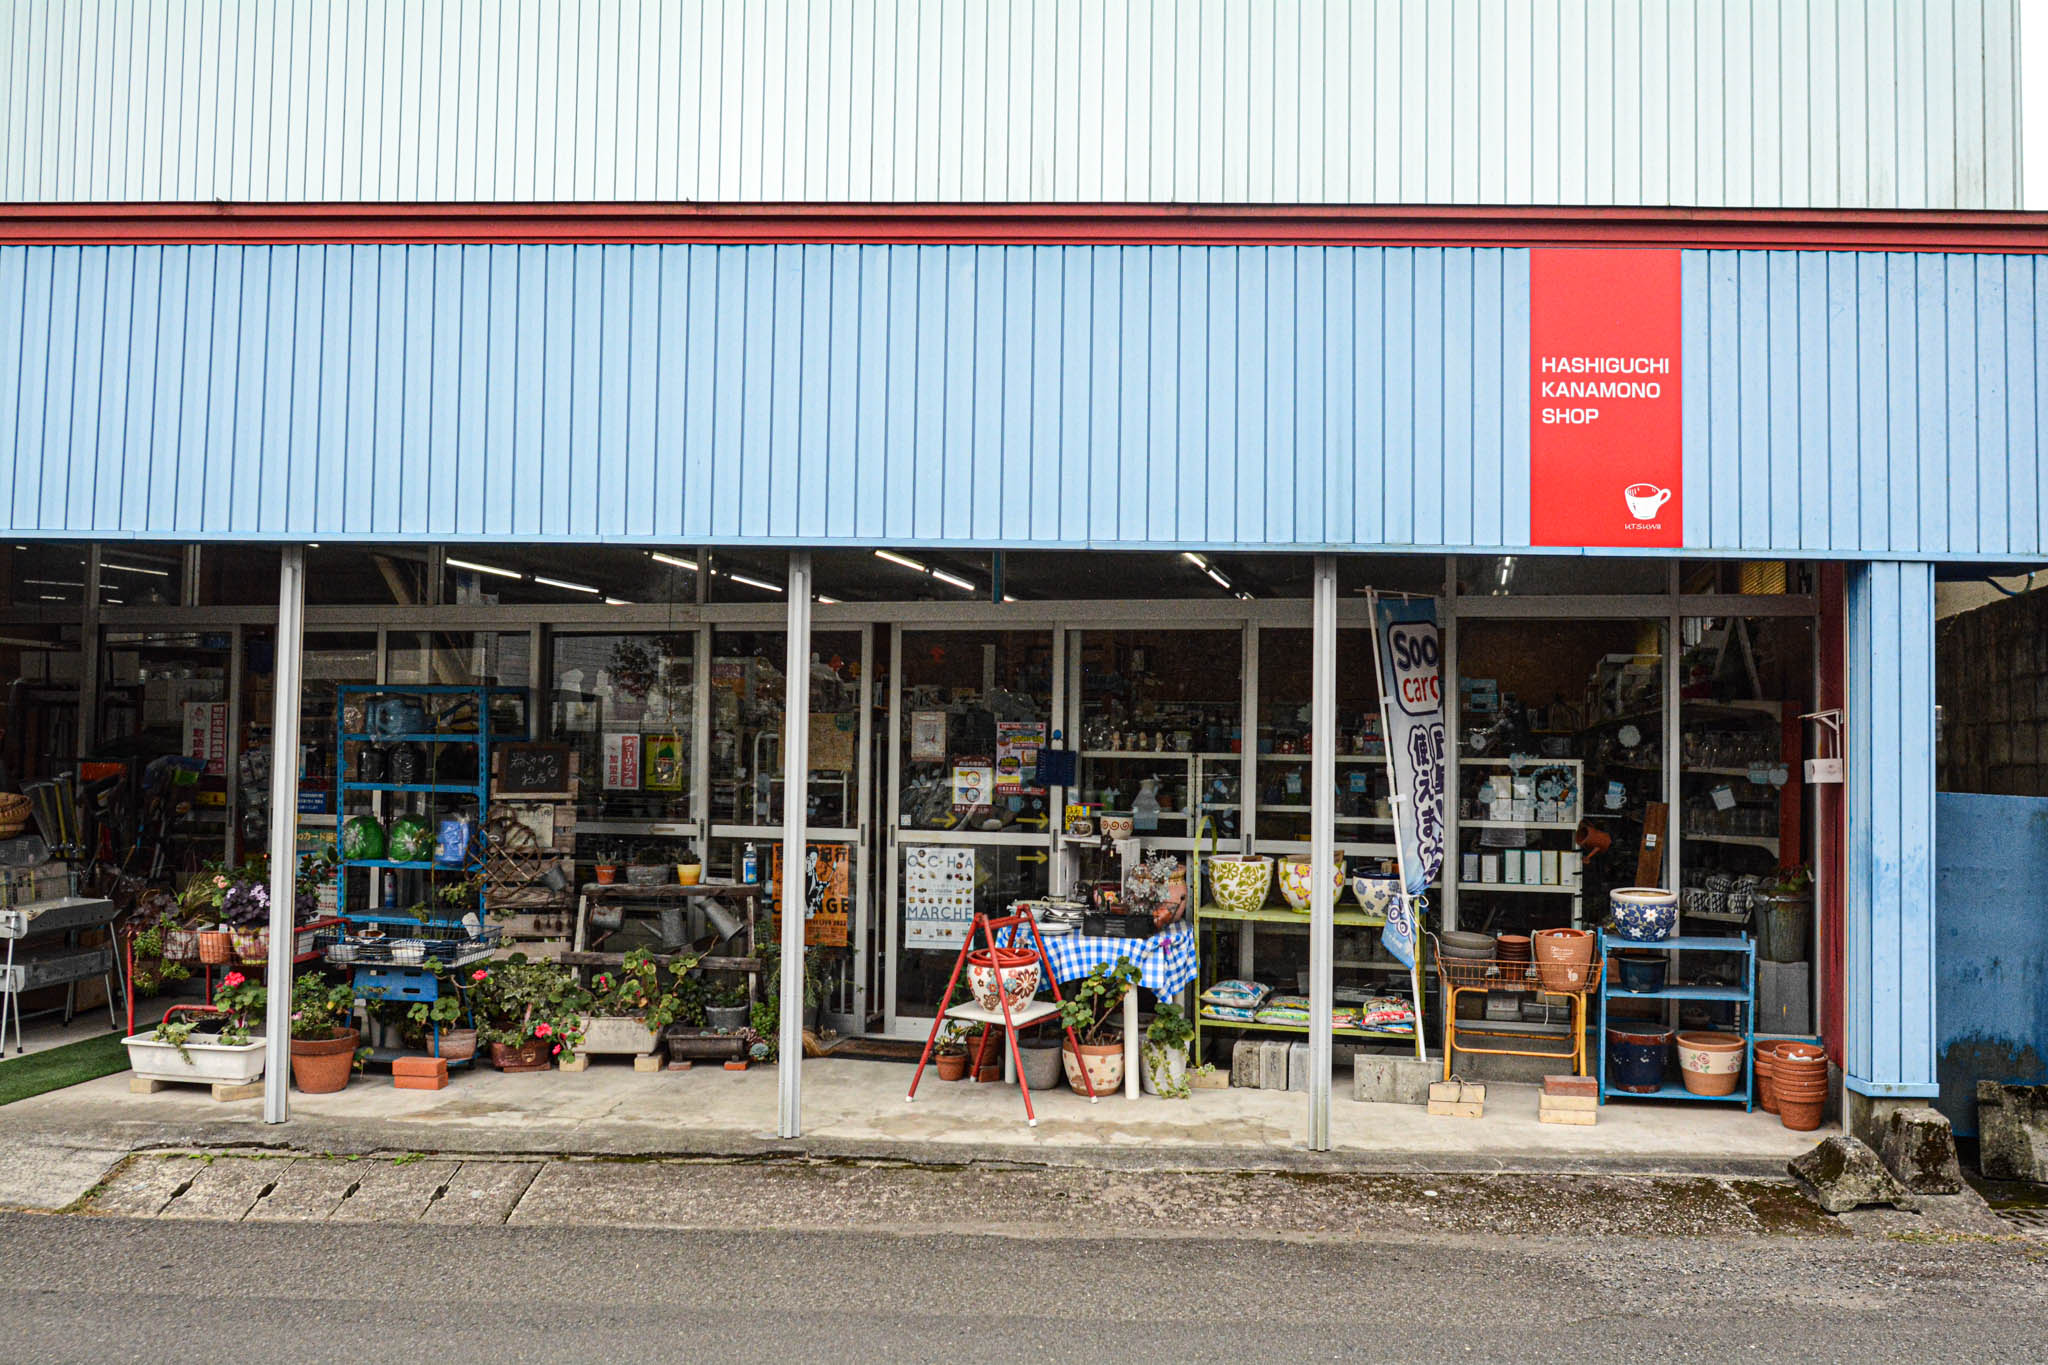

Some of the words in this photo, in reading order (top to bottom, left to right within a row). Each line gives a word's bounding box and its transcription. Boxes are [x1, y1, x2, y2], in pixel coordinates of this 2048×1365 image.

[1541, 357, 1670, 374] HASHIGUCHI
[1541, 382, 1661, 398] KANAMONO
[1541, 408, 1599, 424] SHOP
[907, 906, 973, 920] MARCHE
